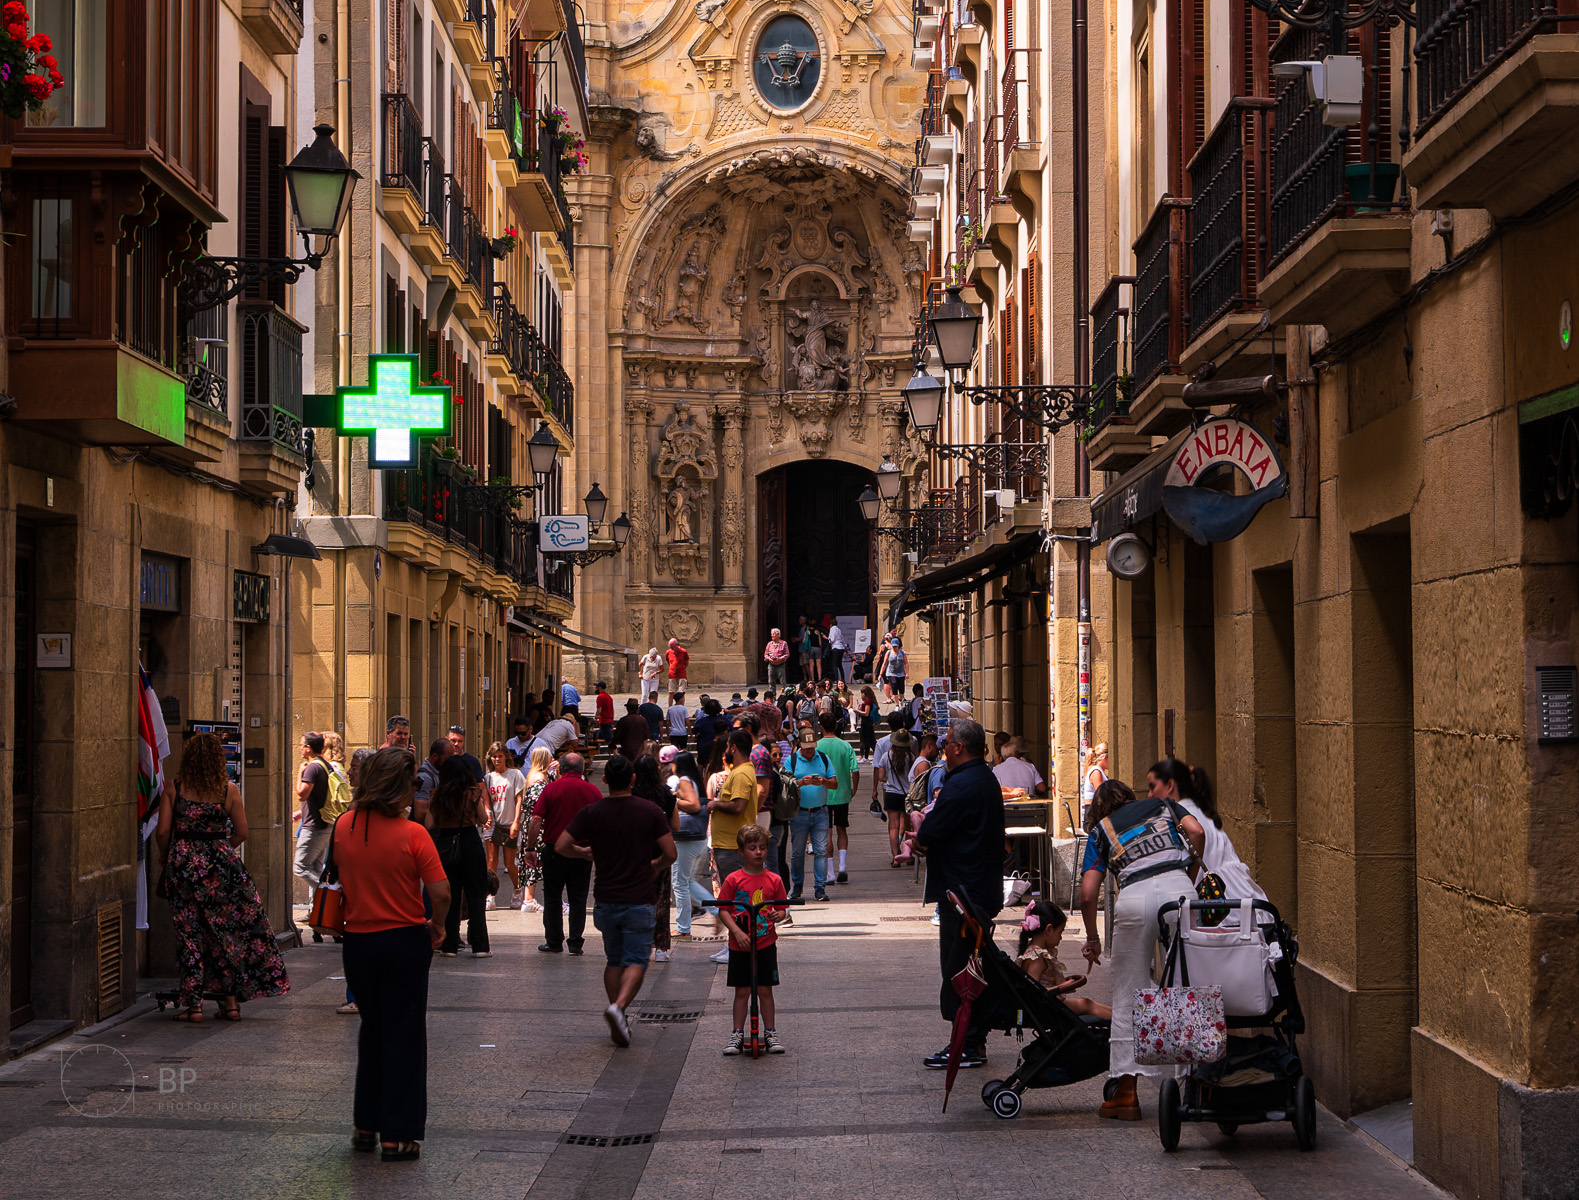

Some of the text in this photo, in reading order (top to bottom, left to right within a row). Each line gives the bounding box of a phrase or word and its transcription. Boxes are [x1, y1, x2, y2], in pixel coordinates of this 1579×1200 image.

[1176, 424, 1272, 488] ENBATA
[490, 784, 508, 796] BOY
[1131, 832, 1176, 858] LOVE
